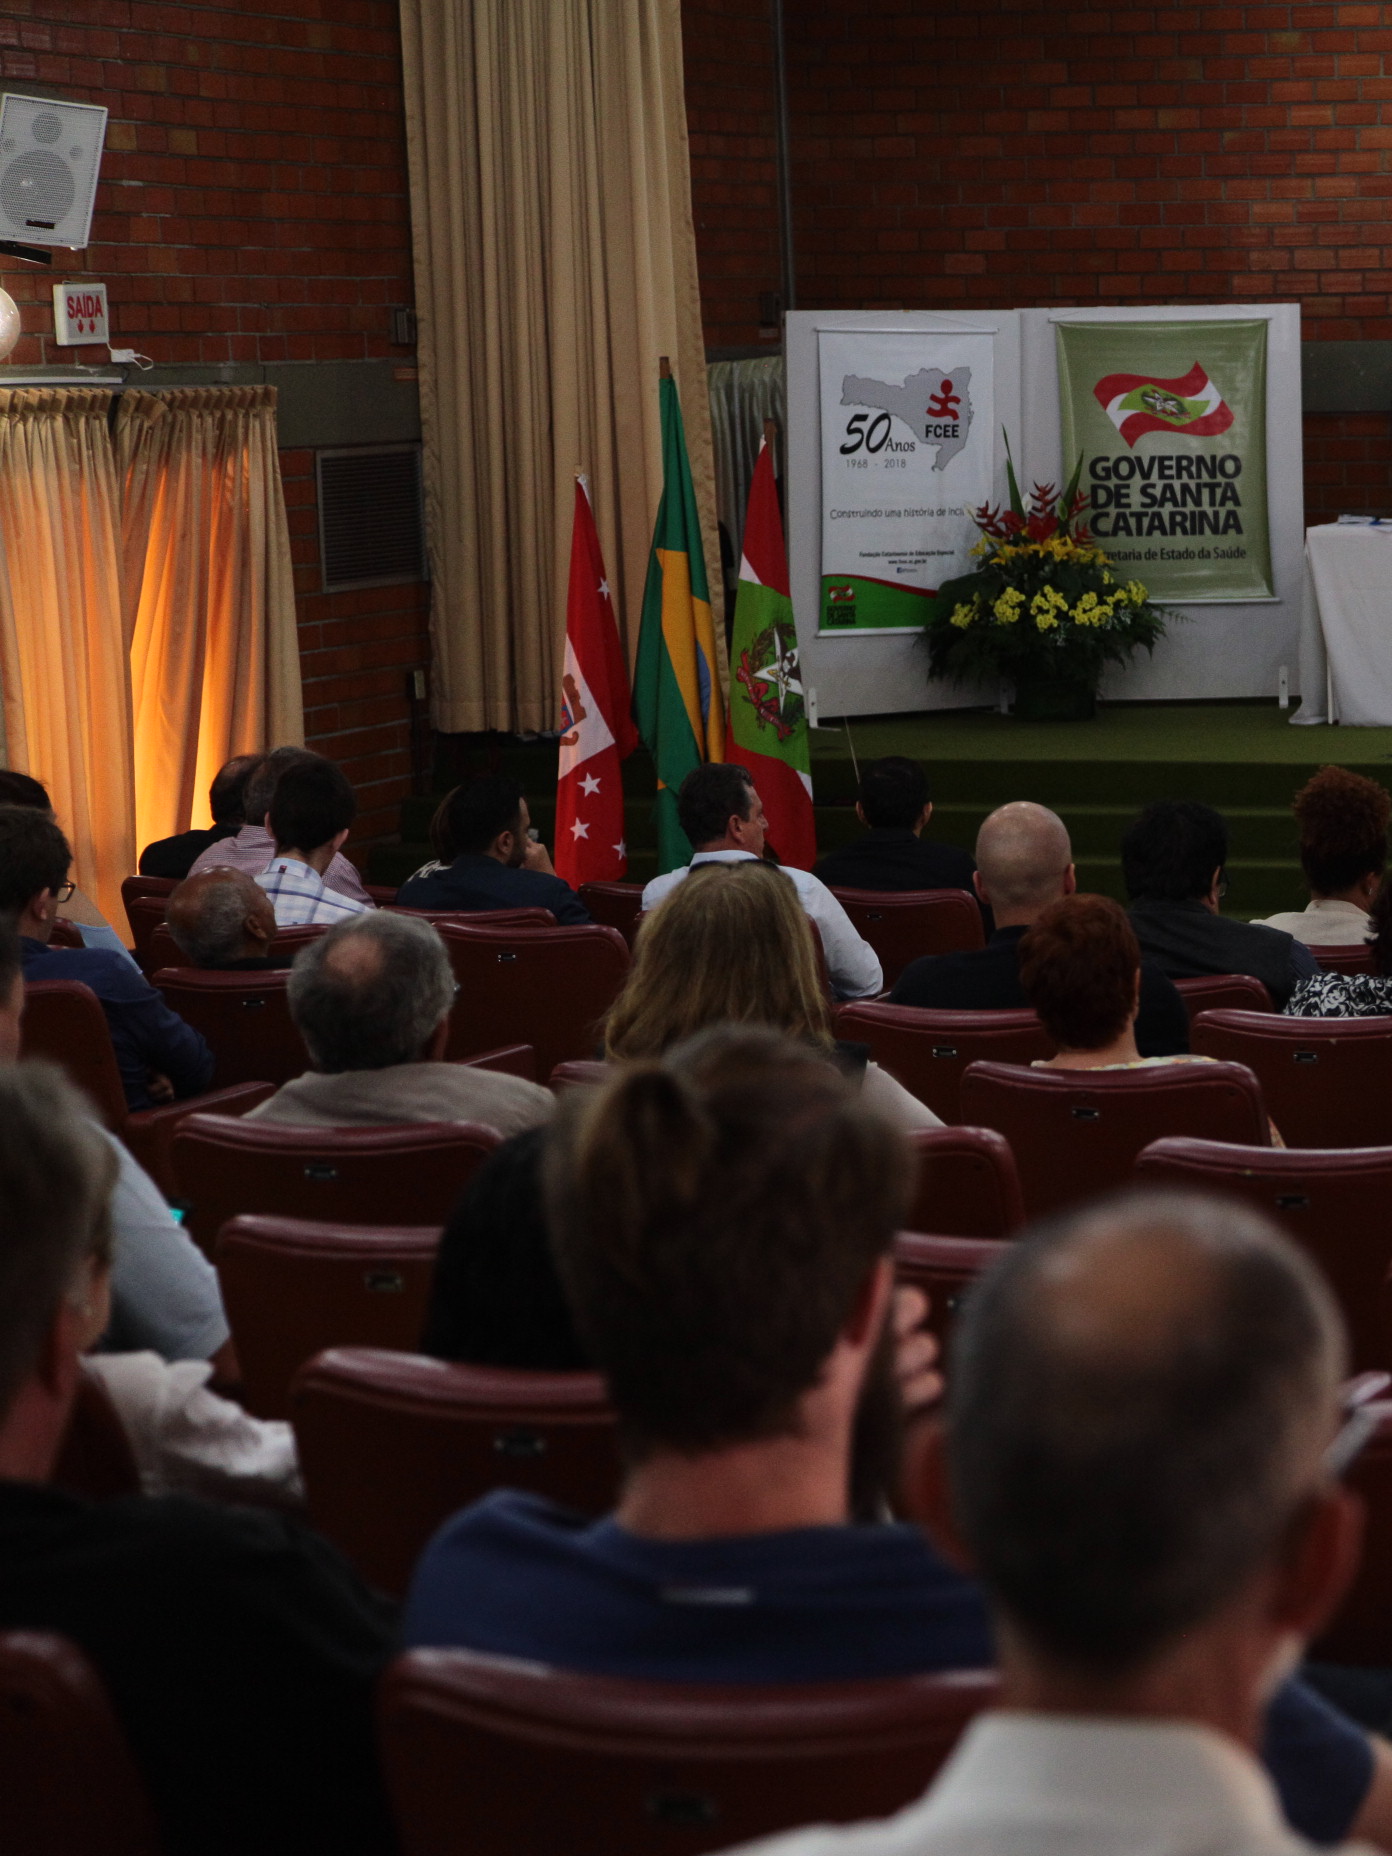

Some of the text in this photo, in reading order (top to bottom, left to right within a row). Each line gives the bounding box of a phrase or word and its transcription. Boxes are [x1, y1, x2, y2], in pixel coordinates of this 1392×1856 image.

[67, 292, 103, 319] SAÍDA
[840, 412, 916, 455] 50 Anos
[925, 424, 960, 438] FCEE
[846, 459, 868, 469] 1968
[884, 459, 907, 469] 2018
[1089, 454, 1242, 481] GOVERNO
[1090, 482, 1241, 509] DE SANTA
[830, 508, 883, 520] Construindo
[885, 509, 902, 518] uma
[936, 507, 947, 517] de
[1090, 510, 1243, 537] CATARINA
[1104, 546, 1247, 561] retaria de Estado da Saúde
